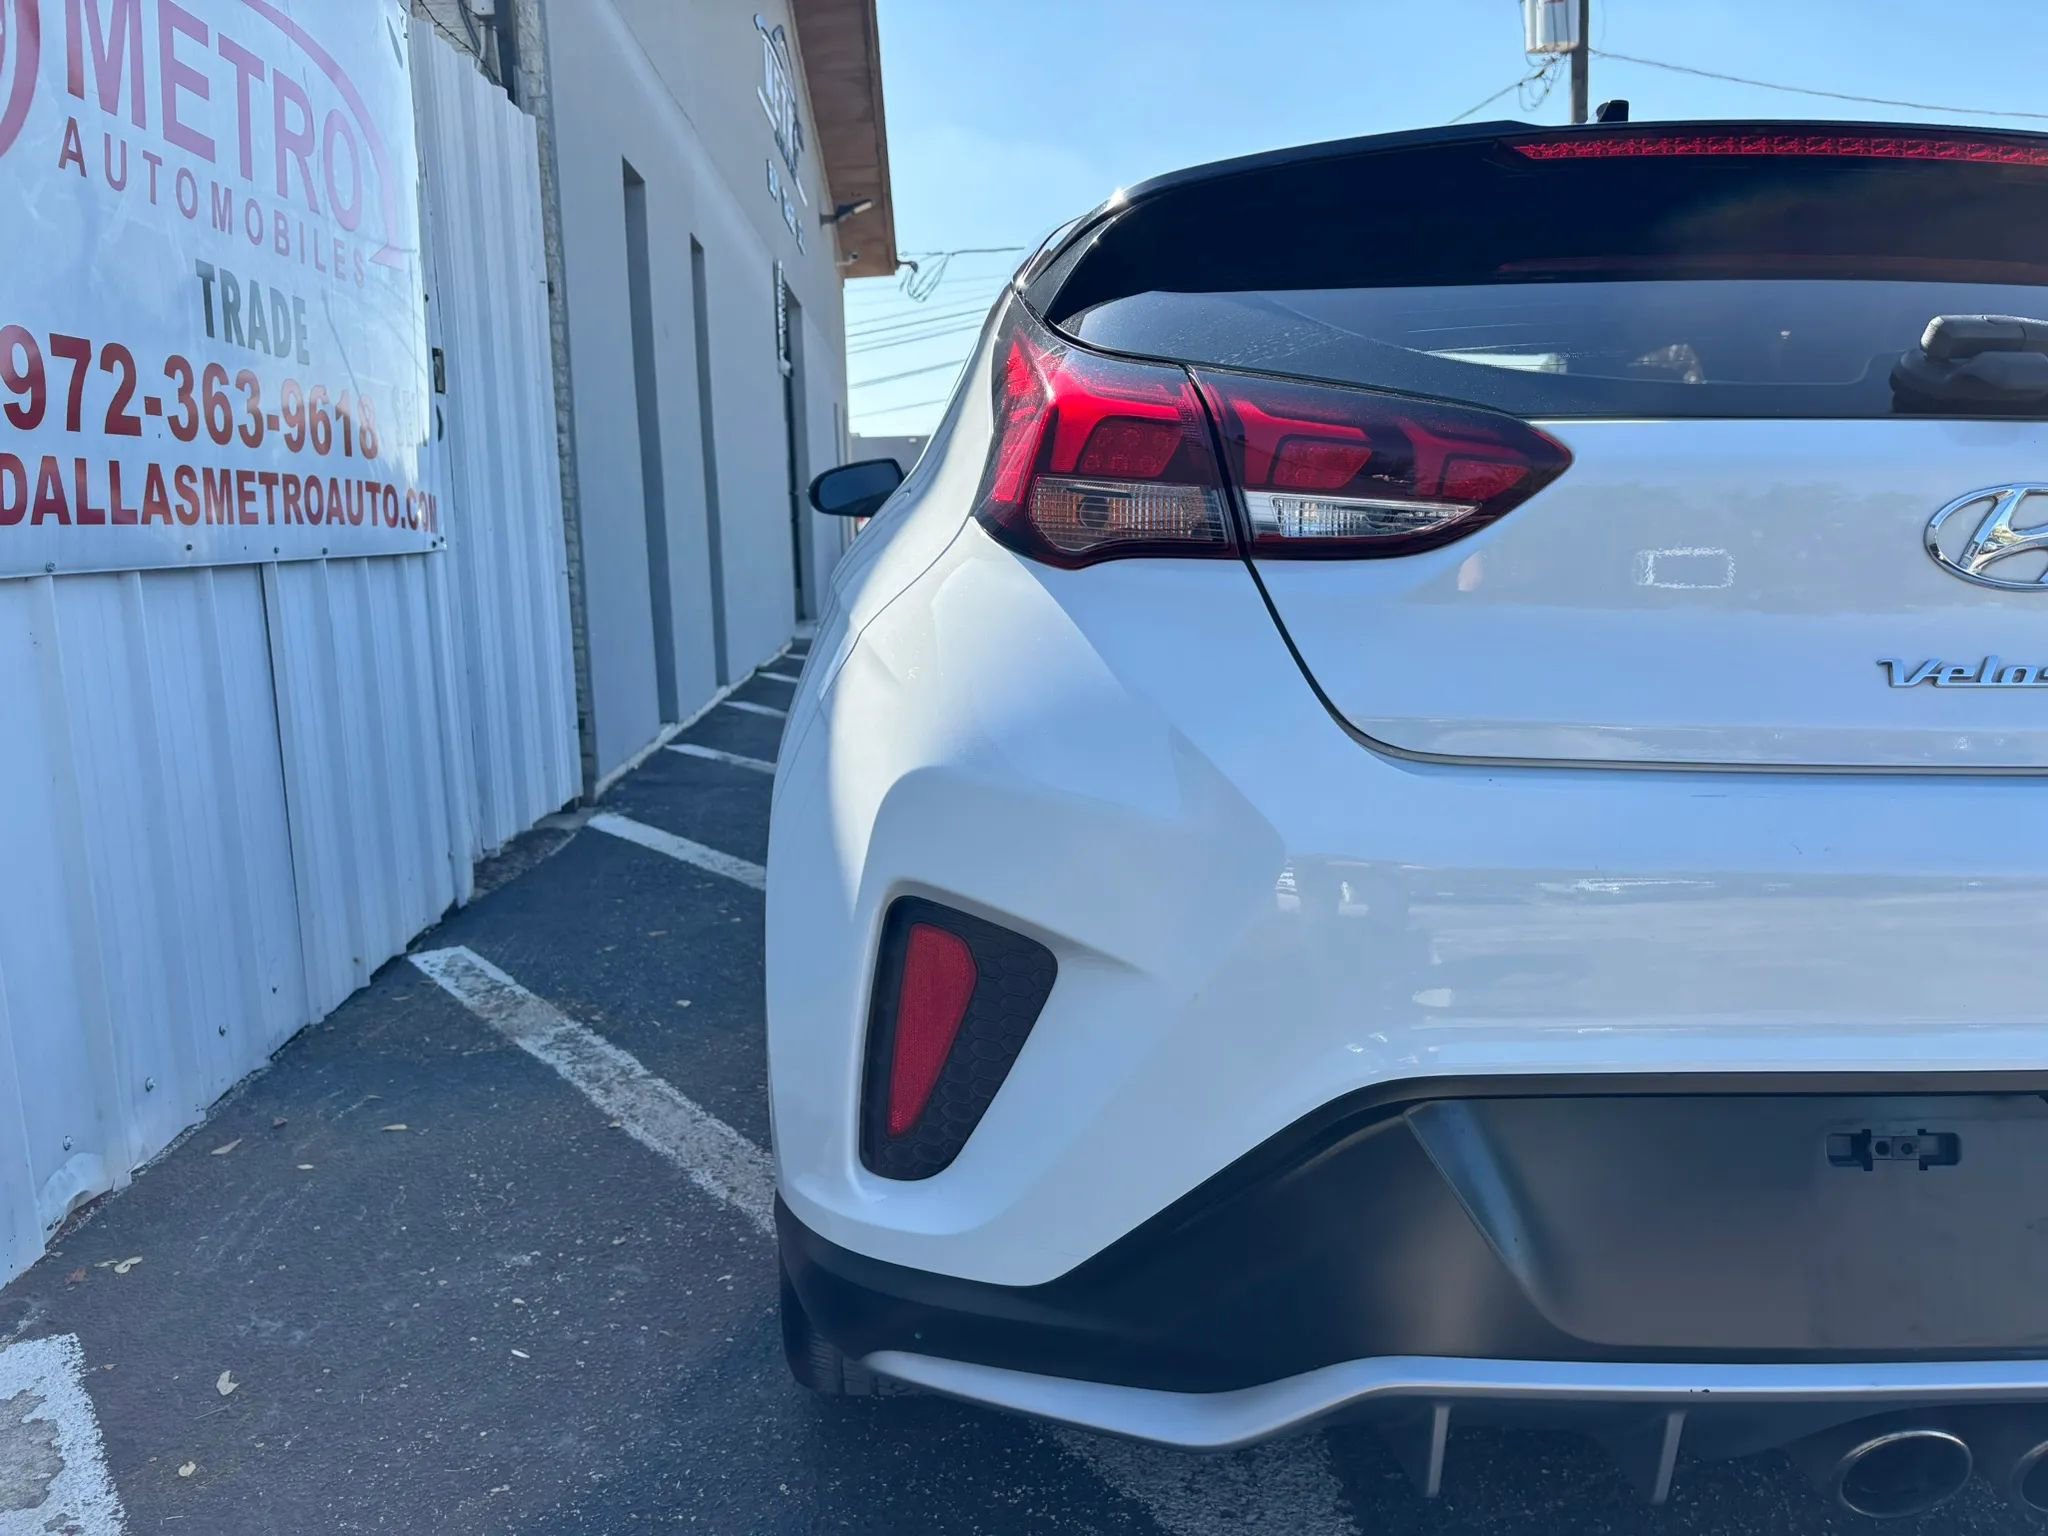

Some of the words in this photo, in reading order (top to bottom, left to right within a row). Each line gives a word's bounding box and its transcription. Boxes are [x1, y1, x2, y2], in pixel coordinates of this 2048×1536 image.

[66, 0, 361, 232] METRO
[58, 116, 365, 288] AUTOMOBILES
[195, 258, 310, 366] TRADE
[1, 324, 378, 459] 972-363-9618
[0, 452, 438, 533] DALLASMETROAUTO.COM
[1876, 655, 2048, 688] Velo
